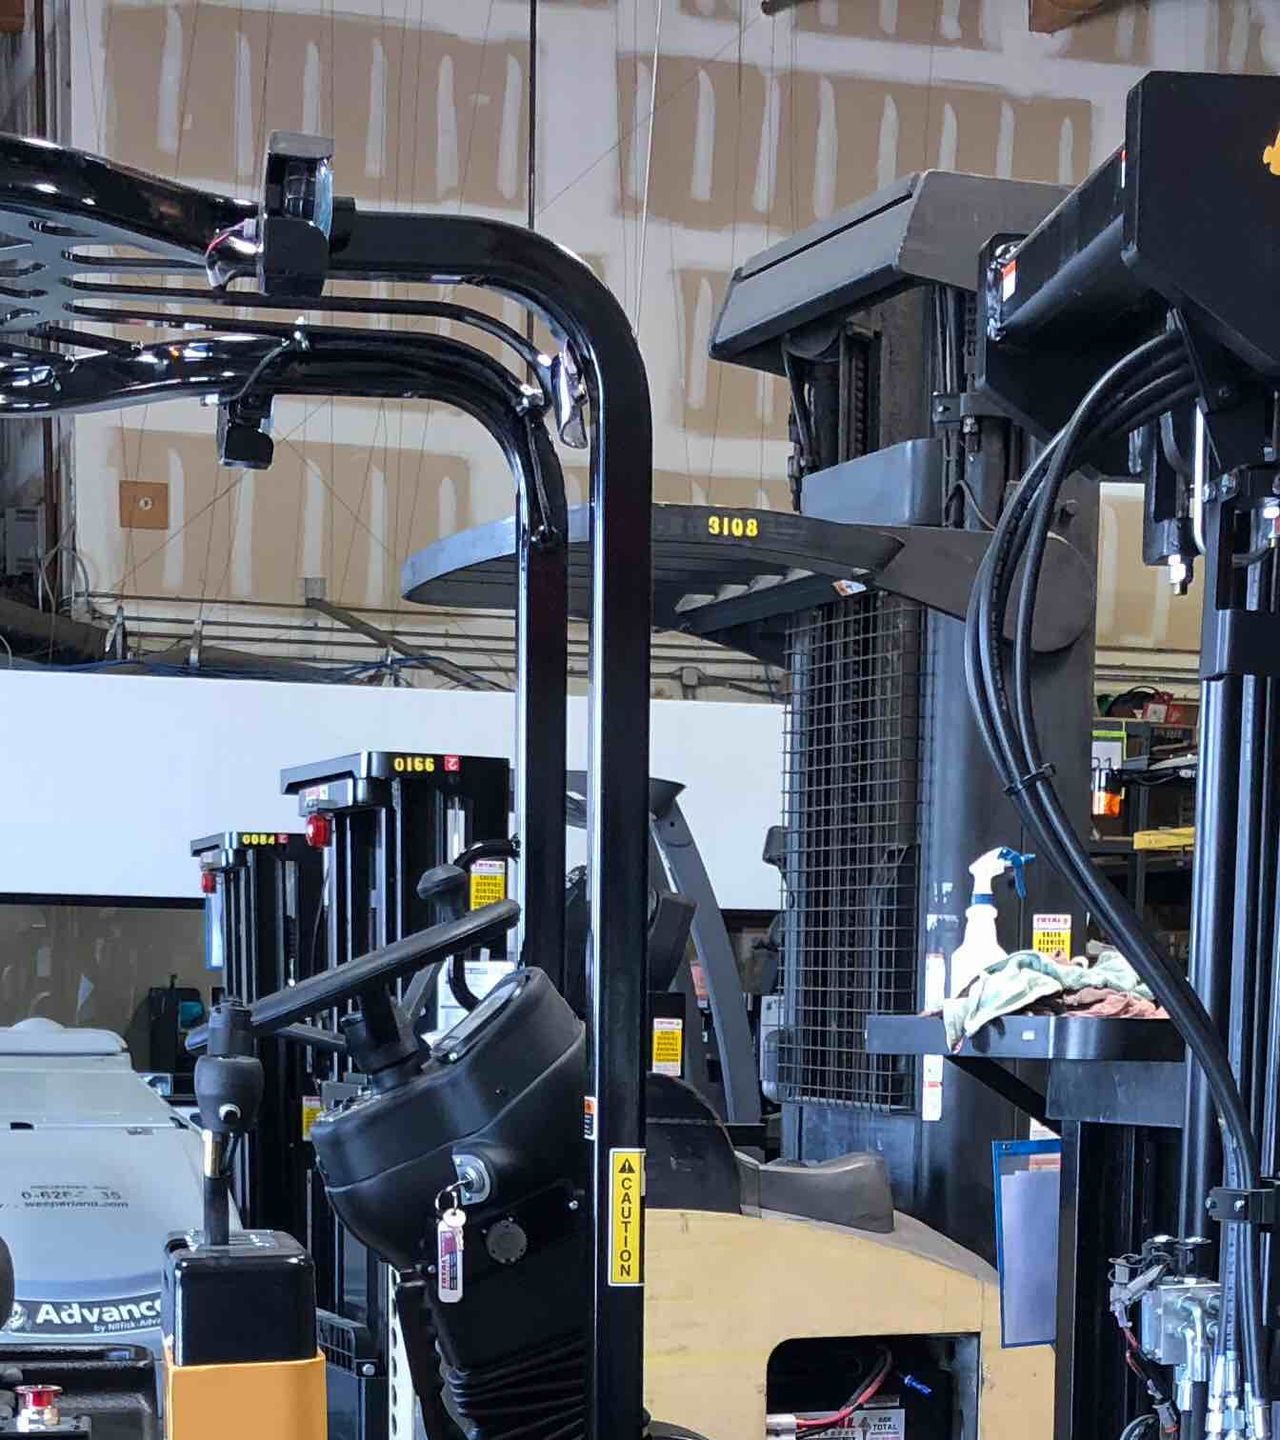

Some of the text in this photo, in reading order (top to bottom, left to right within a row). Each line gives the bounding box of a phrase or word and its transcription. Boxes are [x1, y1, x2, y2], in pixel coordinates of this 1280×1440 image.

[708, 515, 759, 537] 3108
[394, 757, 435, 772] 0166
[618, 1177, 632, 1277] CAUTION
